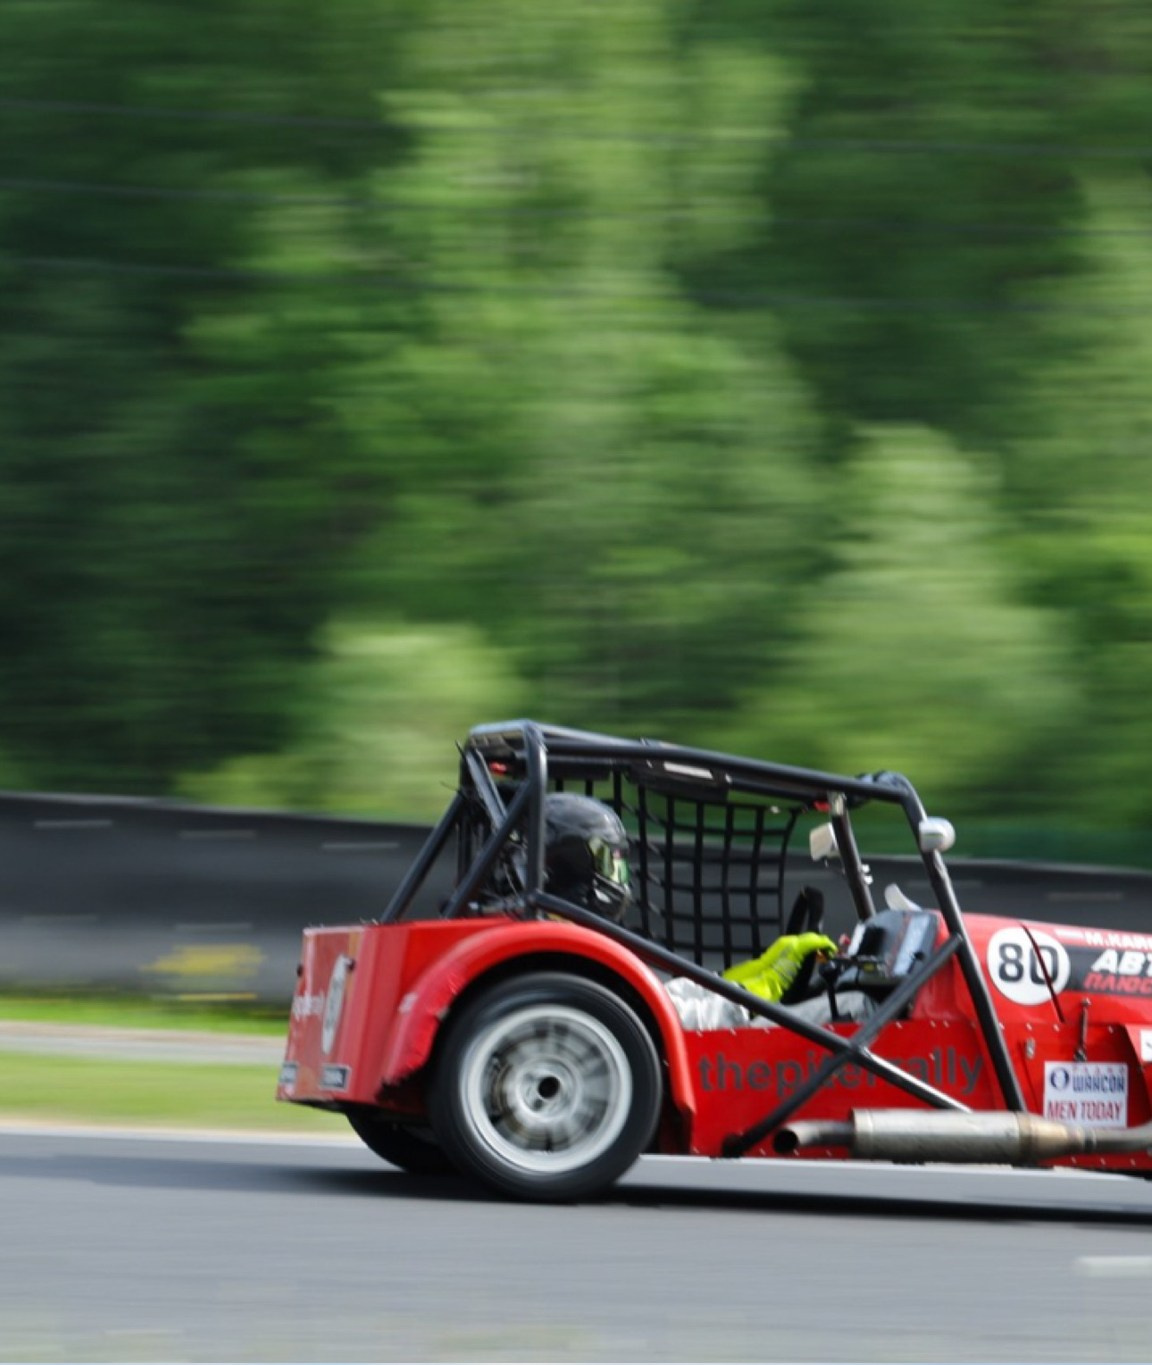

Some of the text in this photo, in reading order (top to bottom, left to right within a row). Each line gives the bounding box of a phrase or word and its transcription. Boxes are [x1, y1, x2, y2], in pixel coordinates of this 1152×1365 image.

[998, 943, 1059, 985] 80
[699, 1046, 983, 1095] thepierally
[1048, 1101, 1121, 1120] MEN TODAY
